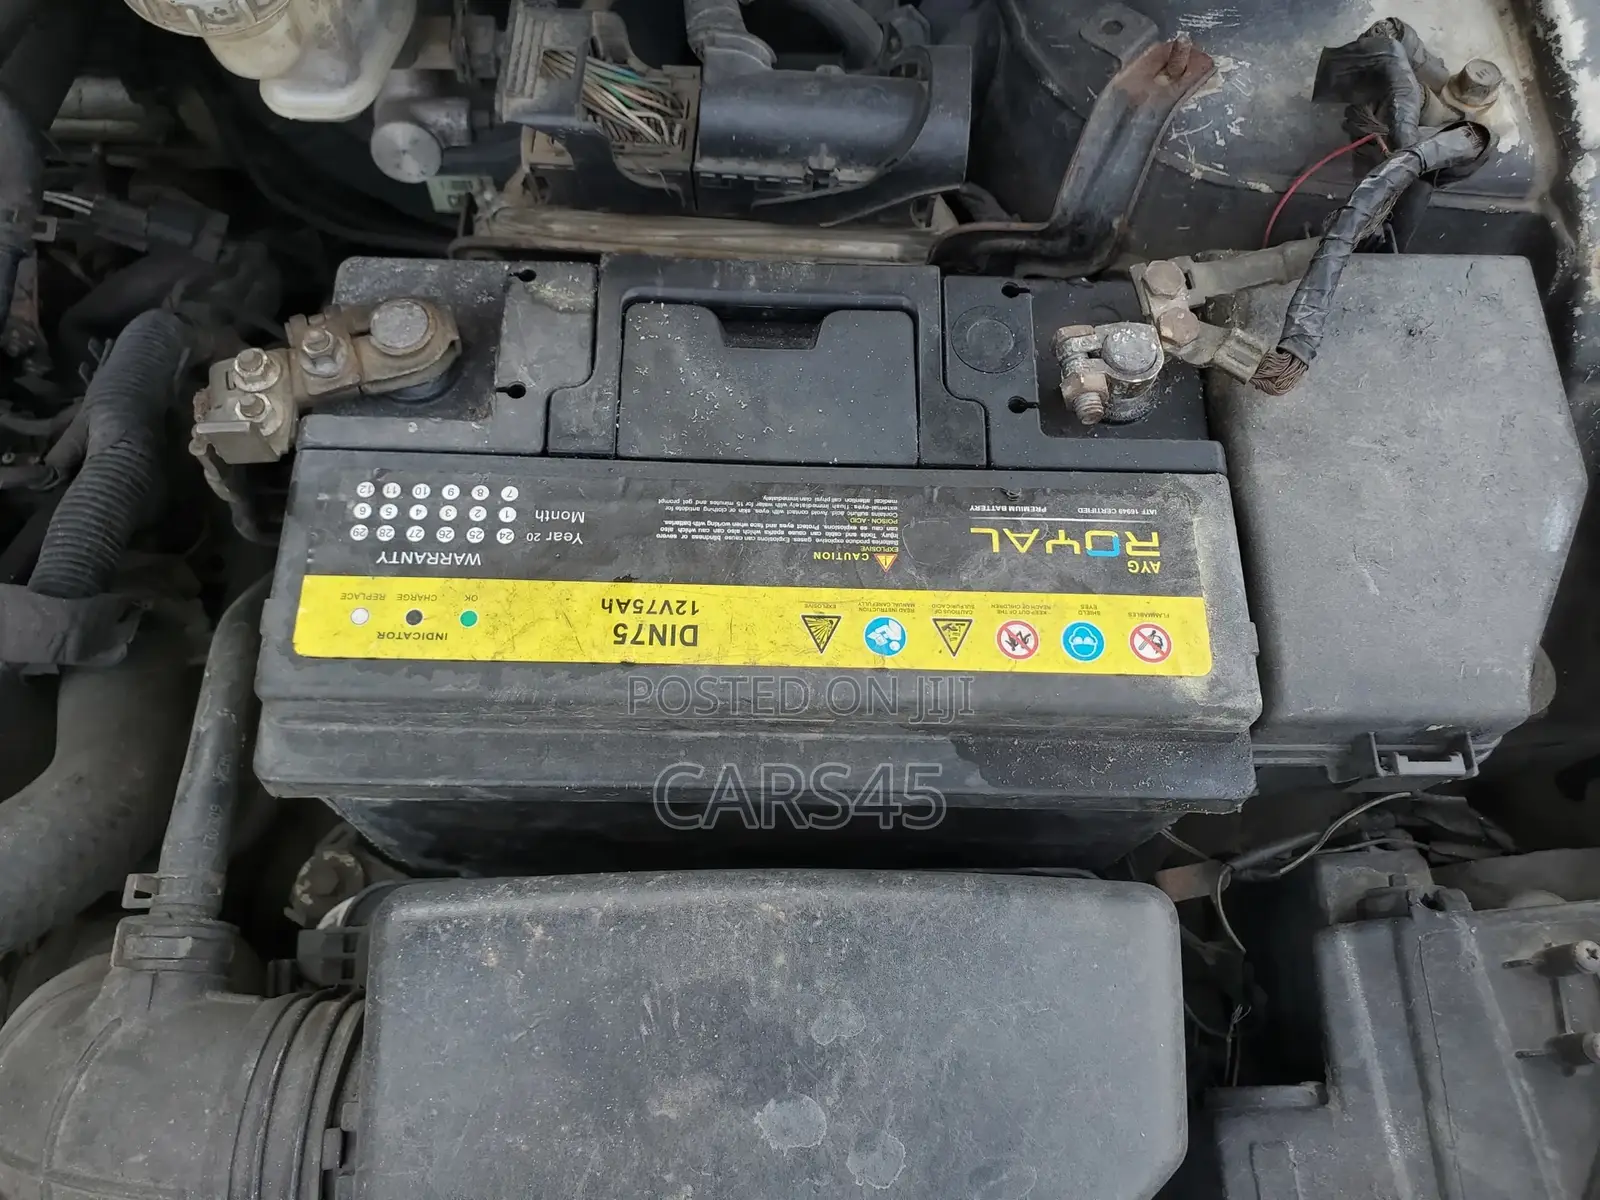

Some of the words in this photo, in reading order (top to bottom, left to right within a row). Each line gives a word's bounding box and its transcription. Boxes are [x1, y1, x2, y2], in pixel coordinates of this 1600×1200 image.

[535, 510, 585, 523] Month
[526, 532, 541, 542] 20
[546, 531, 584, 544] Year
[970, 527, 1160, 558] ROYAL
[376, 551, 482, 566] WARRANTY
[813, 552, 869, 560] CAUTION
[1128, 560, 1161, 573] AYG
[341, 592, 386, 601] REPLACE
[396, 593, 438, 602] CHARGE
[601, 598, 700, 616] 12V75Ah
[376, 632, 448, 640] INDICATOR
[613, 623, 698, 647] DIN75
